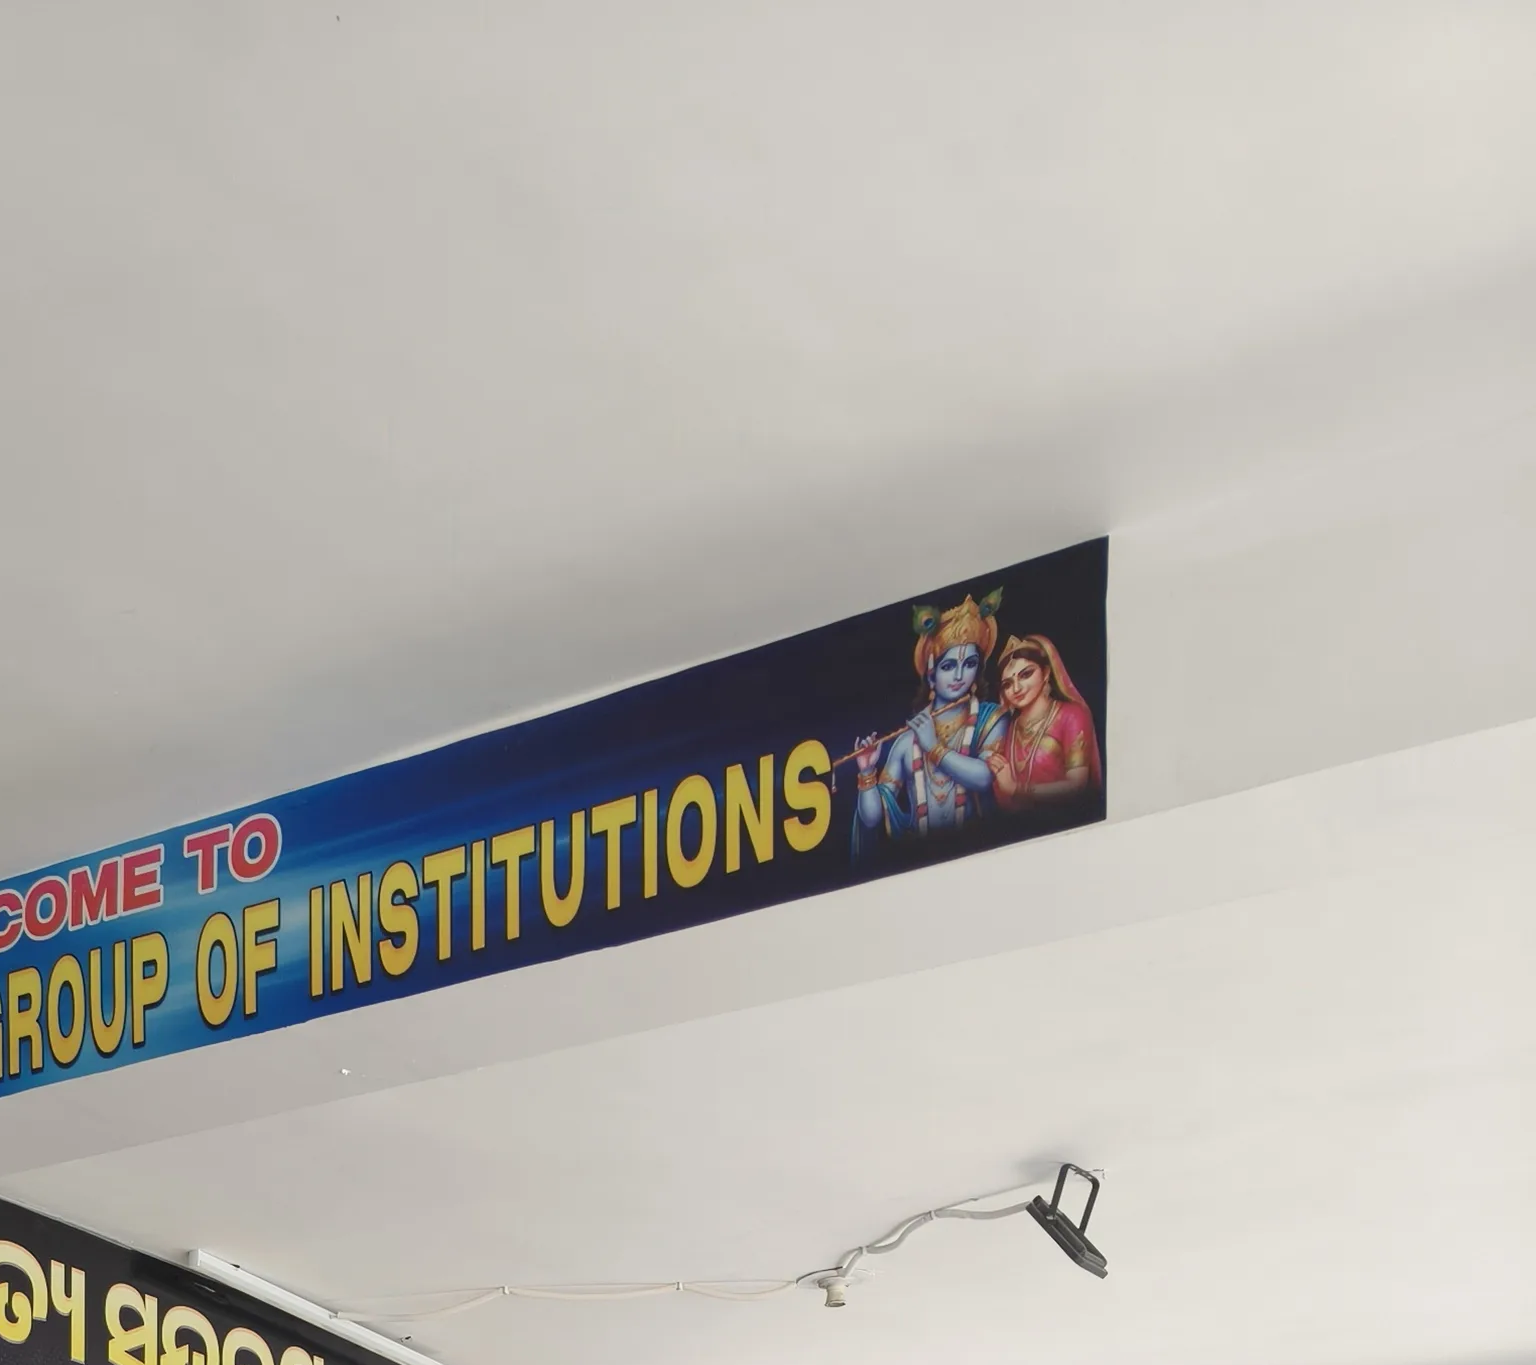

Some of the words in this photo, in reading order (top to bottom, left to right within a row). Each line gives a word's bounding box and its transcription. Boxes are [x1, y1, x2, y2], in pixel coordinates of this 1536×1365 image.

[185, 813, 281, 894] TO
[196, 898, 280, 1028] OF
[310, 739, 834, 997] INSTITUTIONS
